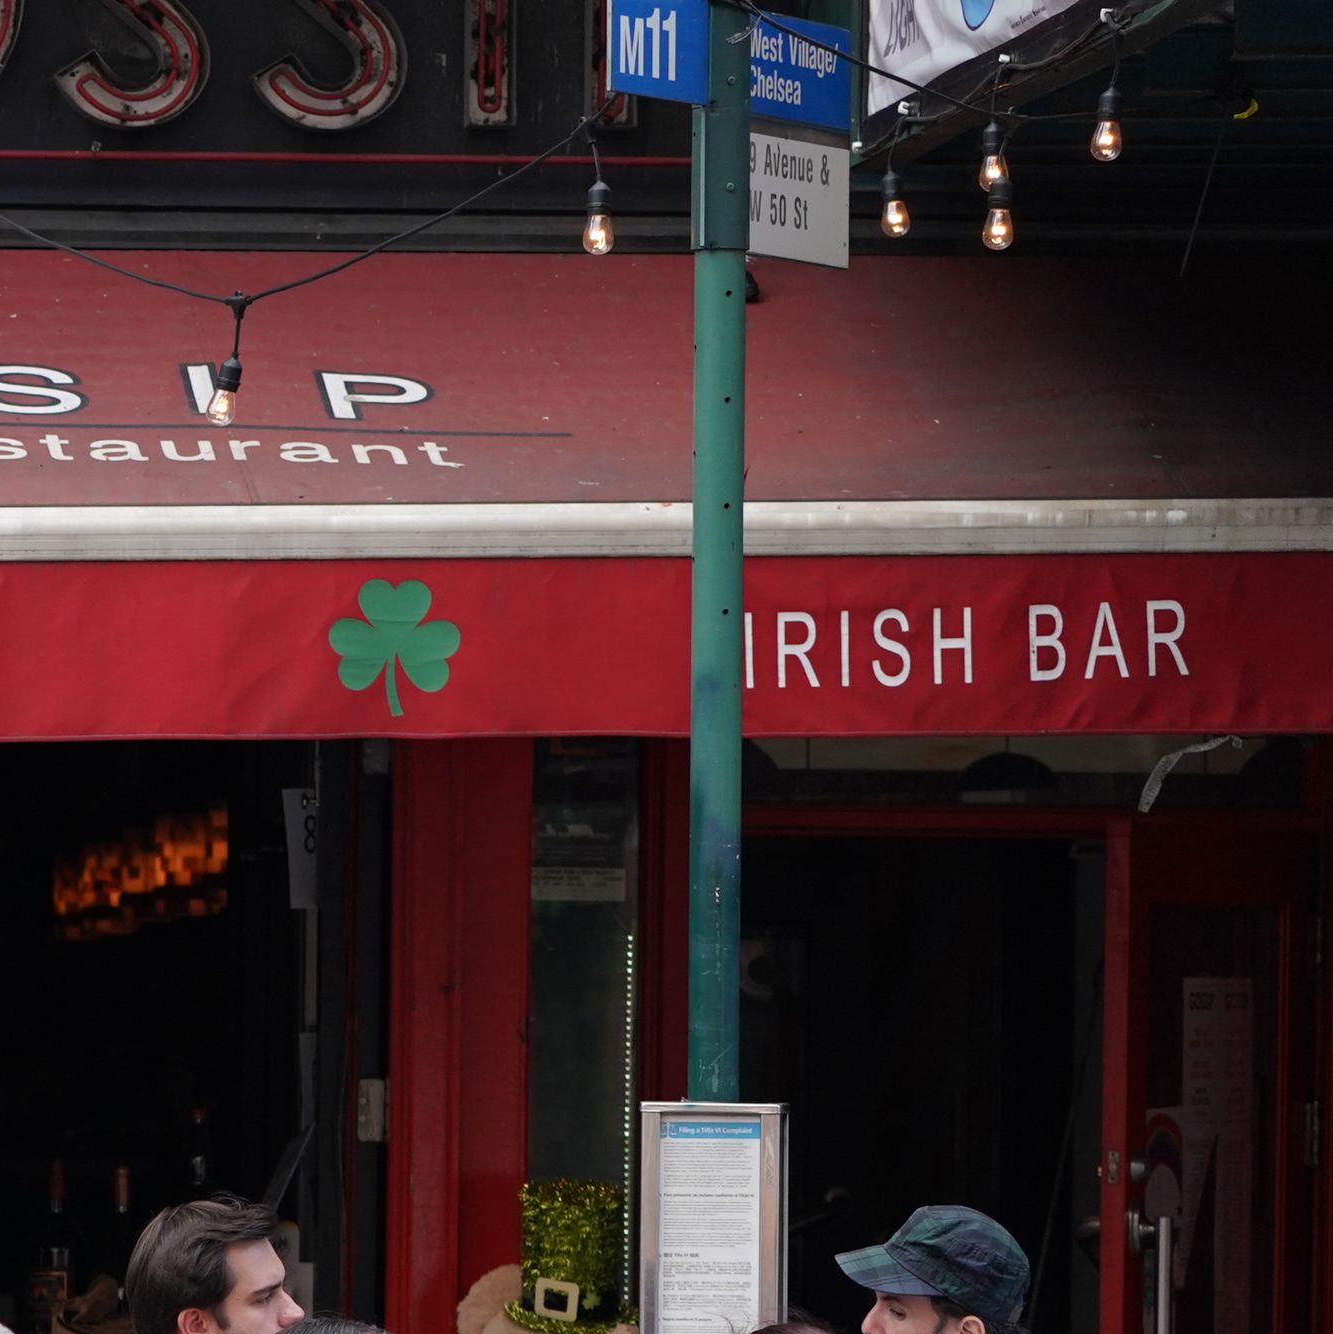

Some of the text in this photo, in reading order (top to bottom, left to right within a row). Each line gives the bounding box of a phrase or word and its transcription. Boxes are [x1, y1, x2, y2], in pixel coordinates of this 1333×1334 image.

[619, 8, 676, 81] M11
[749, 30, 784, 64] West
[749, 65, 802, 105] Chelsea
[764, 142, 814, 185] Avenue
[820, 154, 830, 187] &
[770, 193, 787, 228] 50
[793, 196, 809, 231] St
[744, 599, 1191, 689] IRISH BAR
